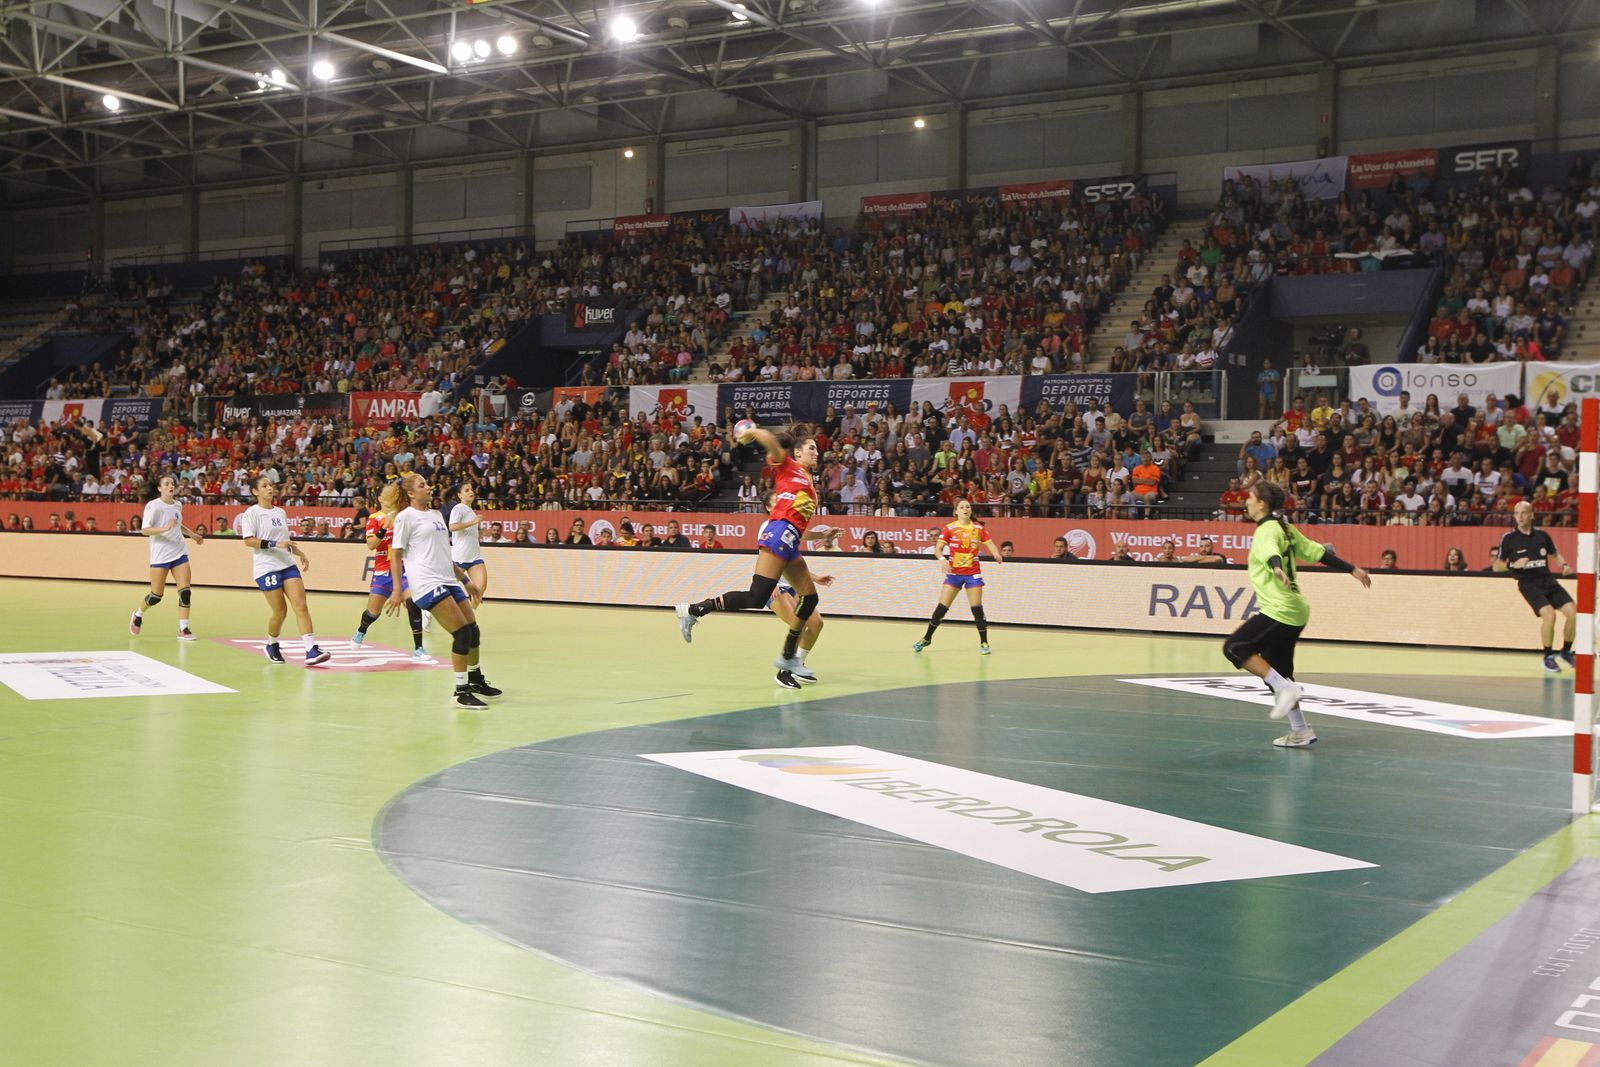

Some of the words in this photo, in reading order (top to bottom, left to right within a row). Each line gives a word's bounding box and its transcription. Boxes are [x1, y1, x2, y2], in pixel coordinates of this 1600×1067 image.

[1351, 164, 1362, 173] La
[1364, 163, 1380, 172] Voz
[585, 306, 615, 324] kuver
[1379, 370, 1477, 389] alonso
[734, 391, 792, 400] DEPORTES
[828, 389, 890, 399] DEPORTES
[1042, 385, 1112, 394] DEPORTES
[272, 518, 282, 526] 88
[1110, 532, 1182, 547] Women's
[265, 574, 277, 586] 88
[832, 776, 1212, 872] IBERDROLA
[1532, 956, 1575, 977] 1933
